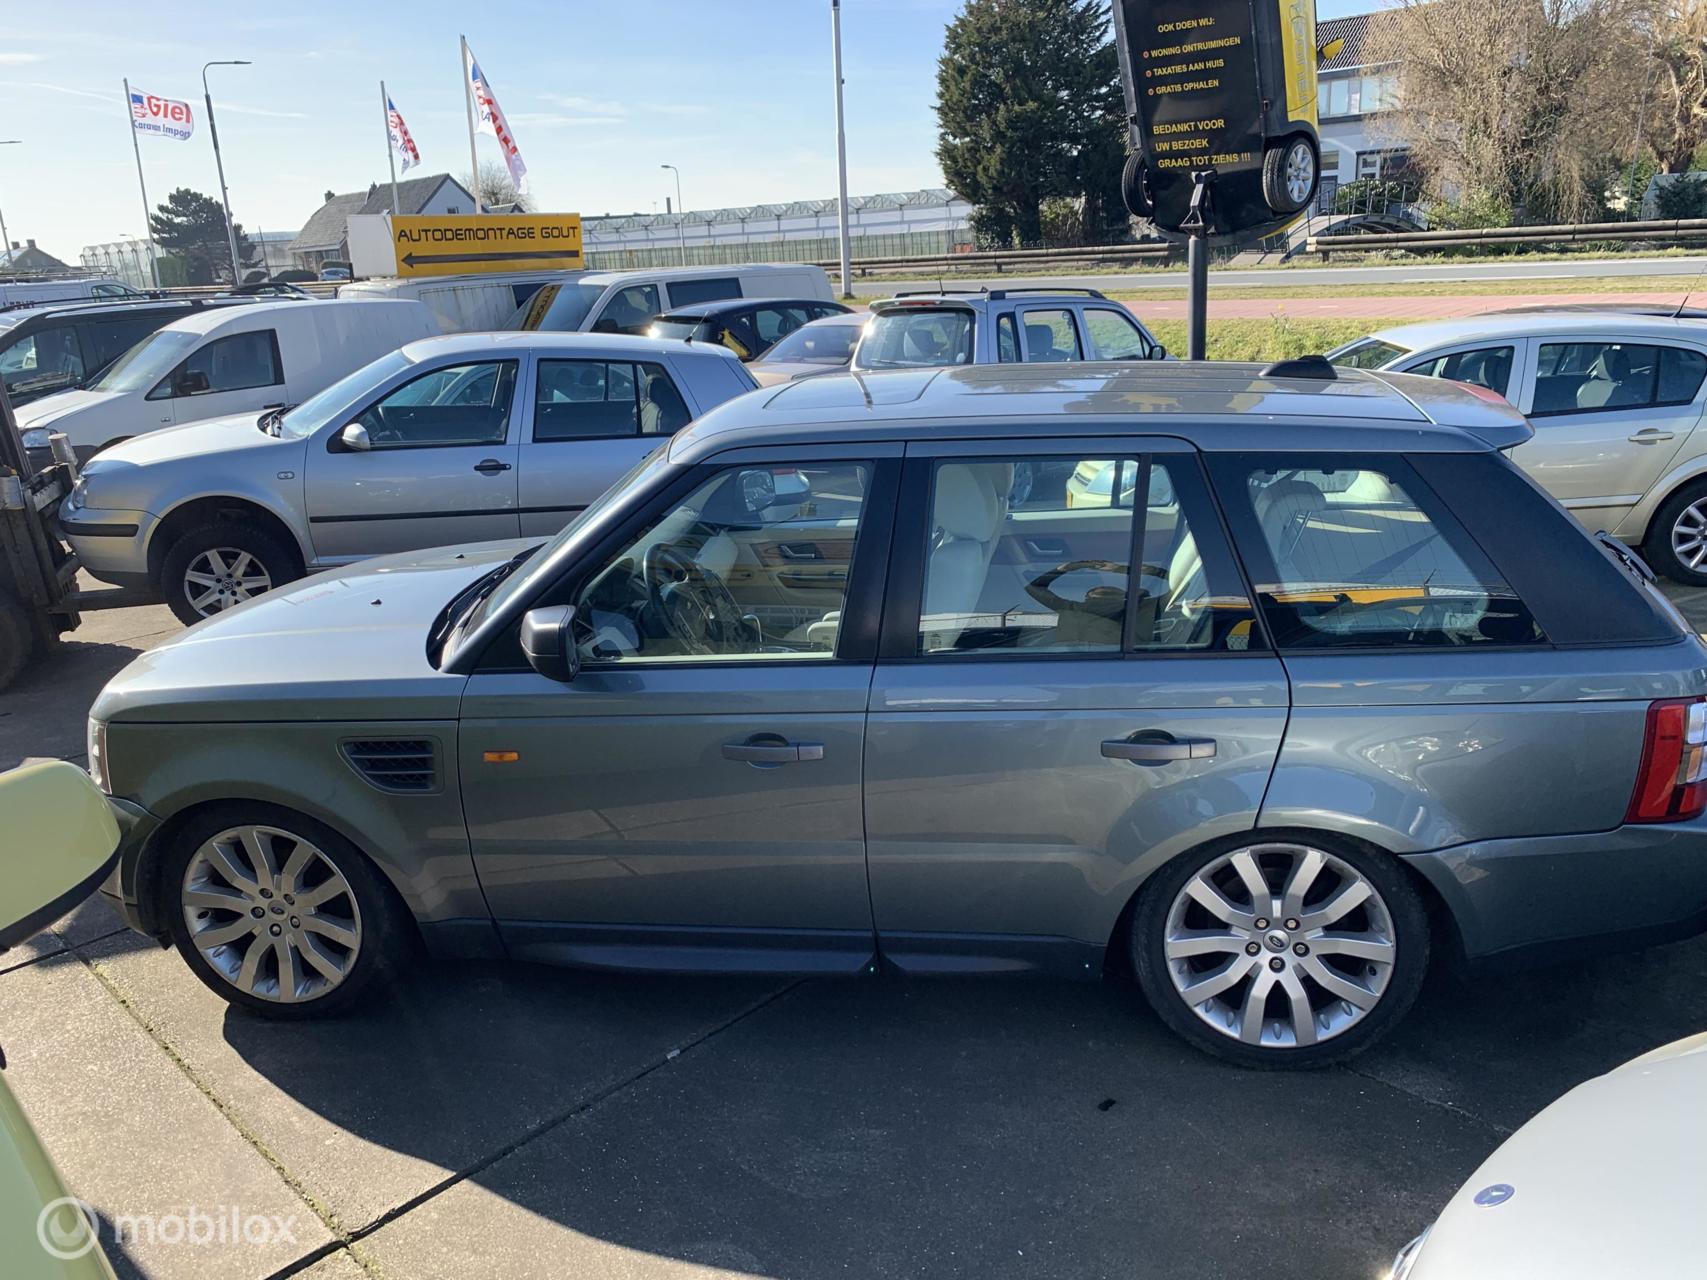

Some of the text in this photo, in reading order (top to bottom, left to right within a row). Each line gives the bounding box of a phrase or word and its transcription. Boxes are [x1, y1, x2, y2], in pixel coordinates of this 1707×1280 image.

[1157, 17, 1215, 33] OOK DOEN WIJ:
[1150, 36, 1240, 58] WONING ONTRUIMINGEN
[1153, 58, 1224, 76] TAXATIES AAN HUIS
[1155, 79, 1219, 95] GRATIS OPHALEN
[146, 95, 191, 124] Giel
[1153, 118, 1225, 135] BEDANKT VOOR
[1155, 138, 1209, 152] UW BEZOEK
[1157, 152, 1251, 169] GRAAG TOT ZIENS !!!
[397, 225, 578, 243] AUTODEMONTAGE GOUT
